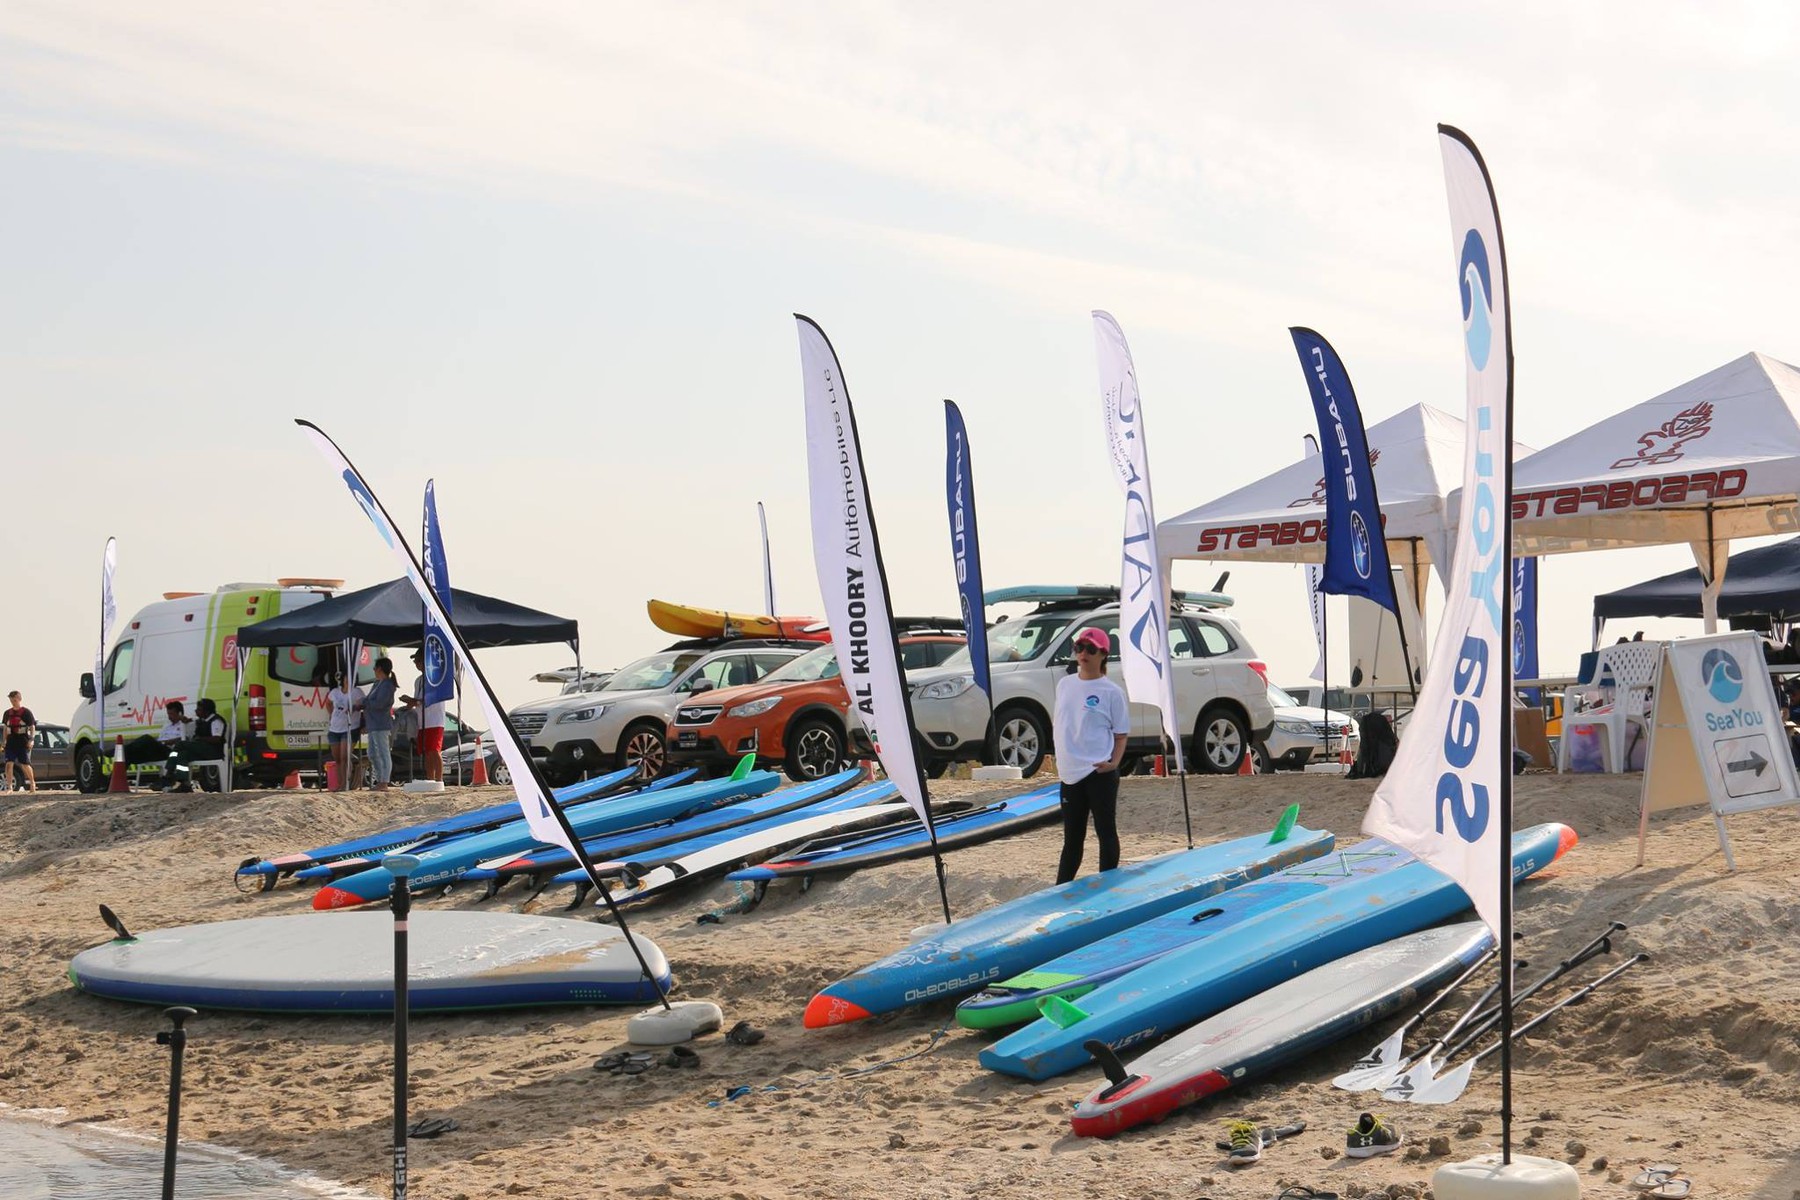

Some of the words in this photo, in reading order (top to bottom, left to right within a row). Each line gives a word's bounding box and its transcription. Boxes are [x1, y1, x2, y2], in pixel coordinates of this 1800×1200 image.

[824, 369, 837, 404] LLC
[1312, 346, 1357, 501] SUBARU
[833, 411, 863, 558] Automobiles
[955, 432, 967, 584] SUBARU
[423, 506, 439, 627] SBARU
[846, 567, 871, 675] KHOORY
[857, 682, 874, 715] AL
[1705, 708, 1763, 732] SeaYou
